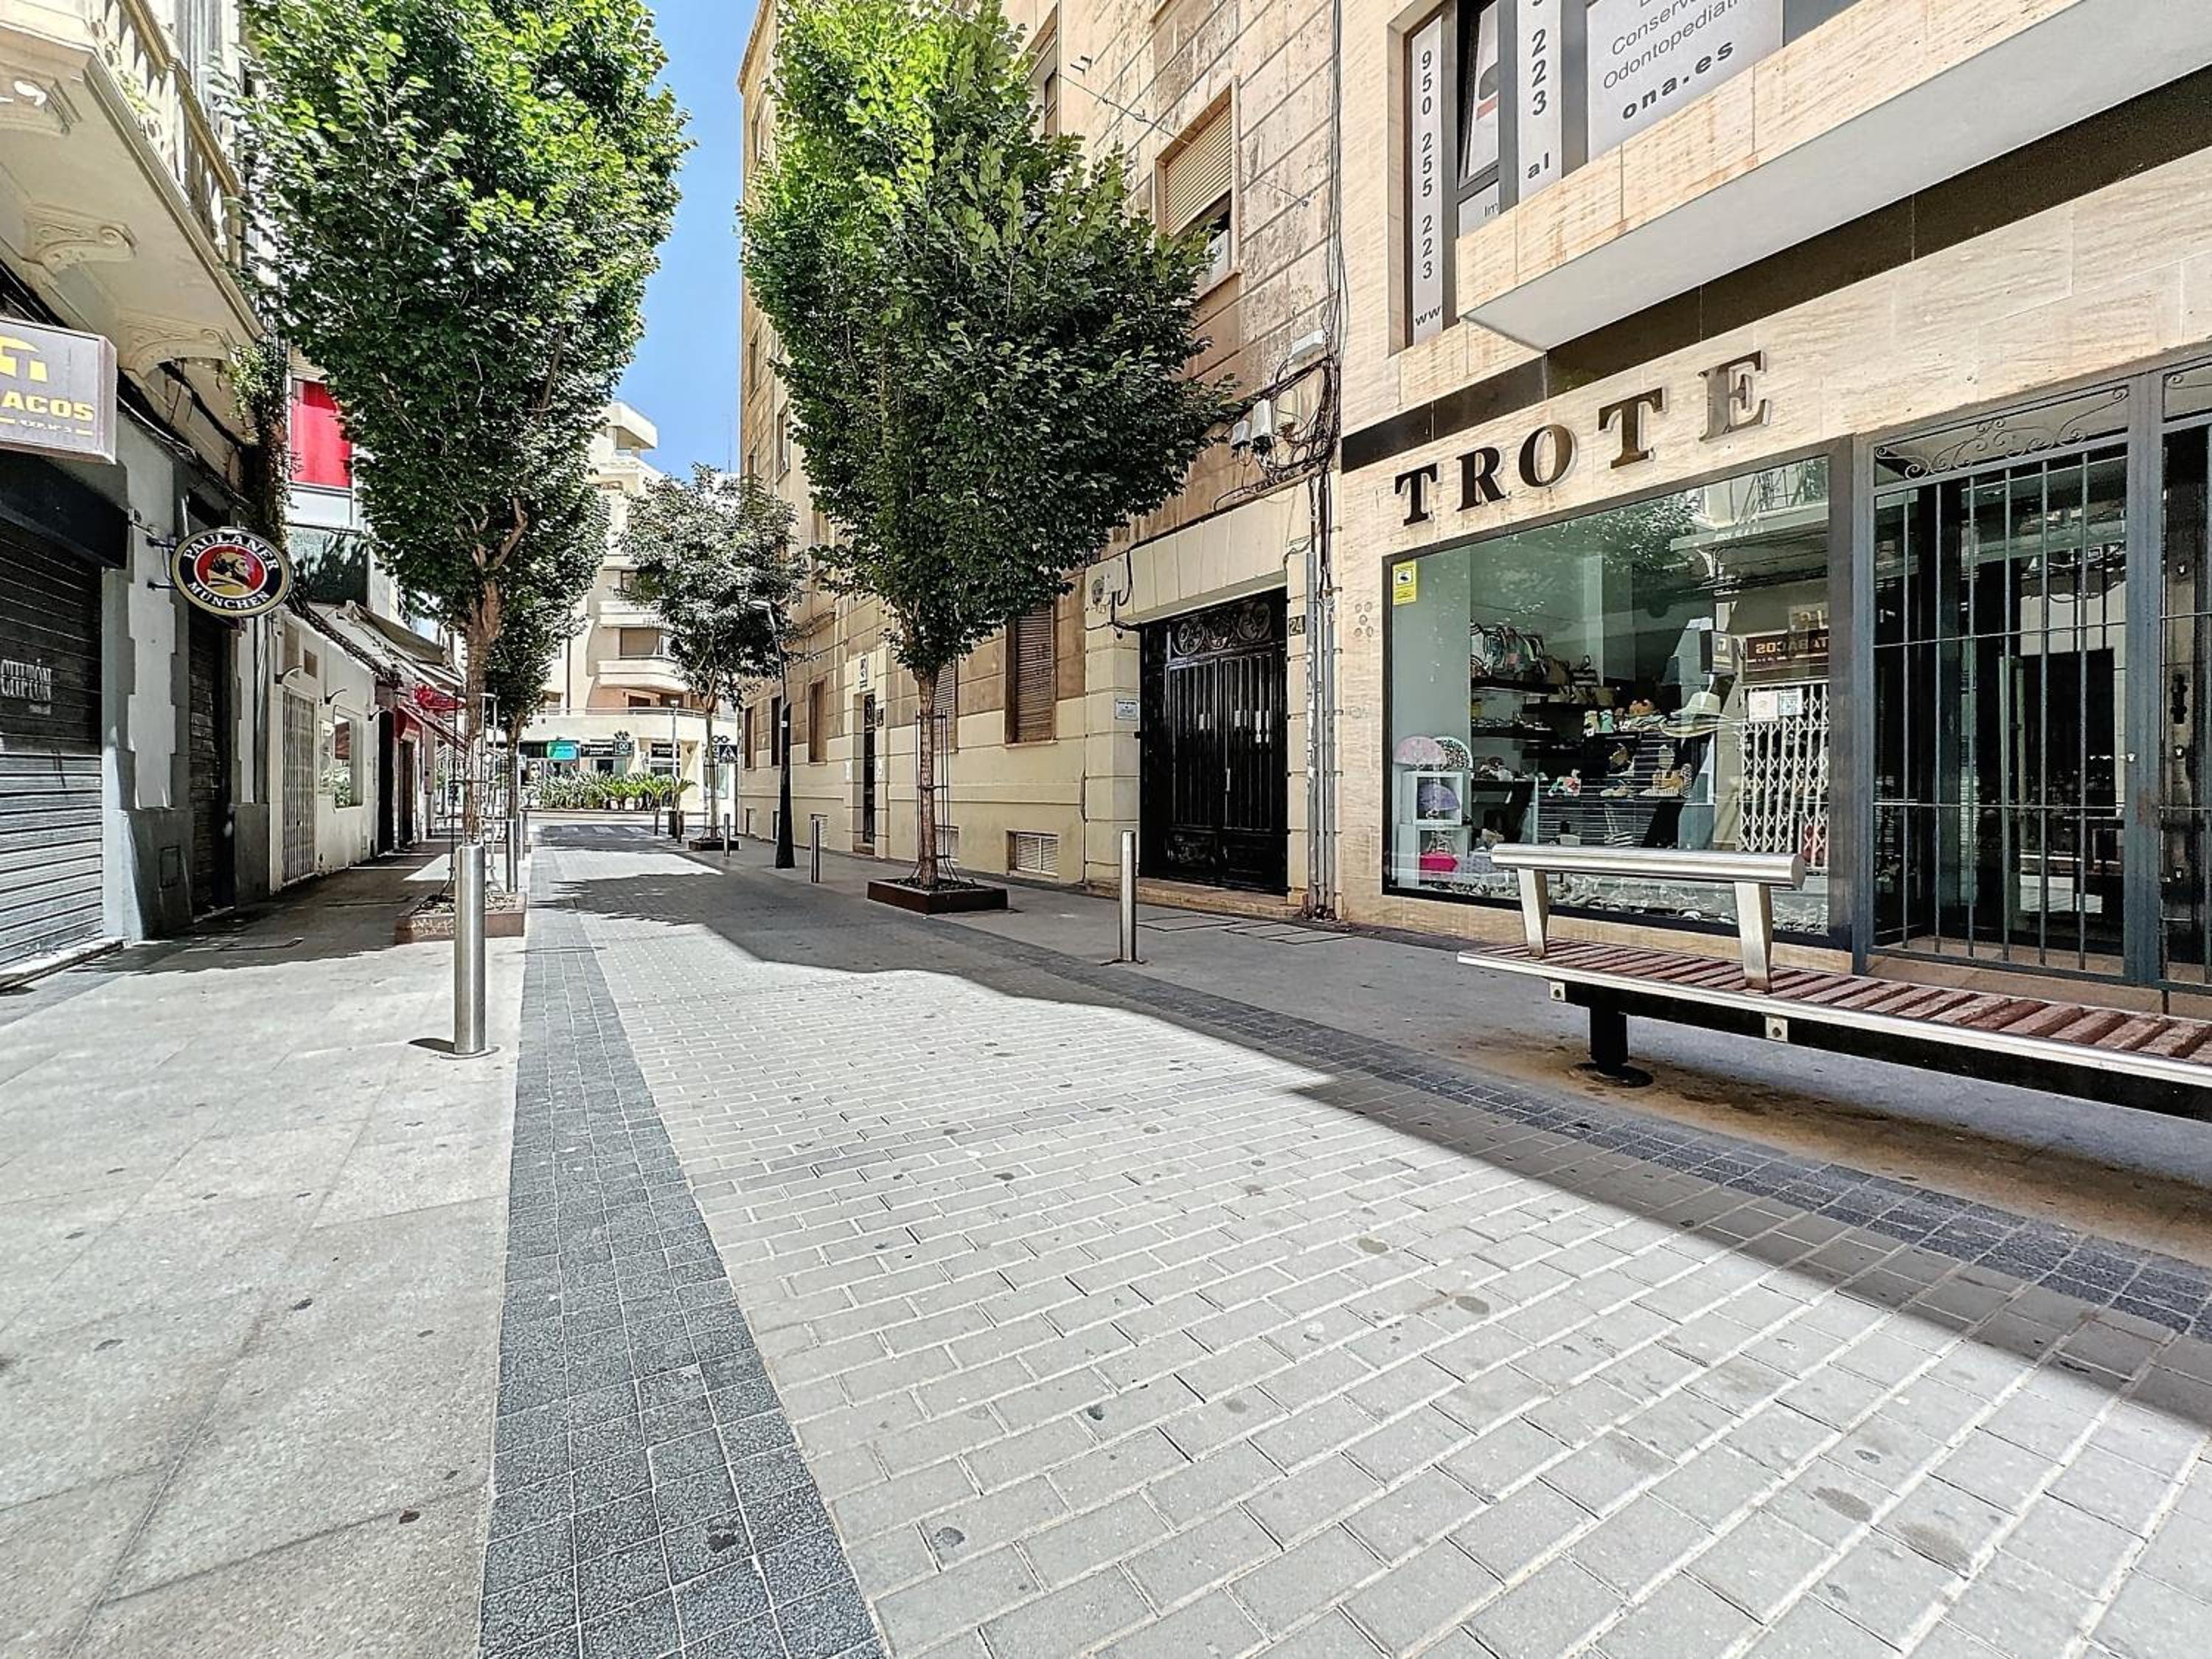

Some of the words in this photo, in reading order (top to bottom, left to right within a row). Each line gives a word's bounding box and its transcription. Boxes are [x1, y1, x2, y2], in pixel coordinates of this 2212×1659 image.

[1422, 49, 1433, 116] 950
[1622, 41, 1733, 120] ona.es
[1422, 131, 1433, 198] 255
[1422, 214, 1433, 280] 223
[1394, 350, 1767, 527] TROTE
[183, 535, 279, 571] PAULANER
[1289, 617, 1303, 635] 24
